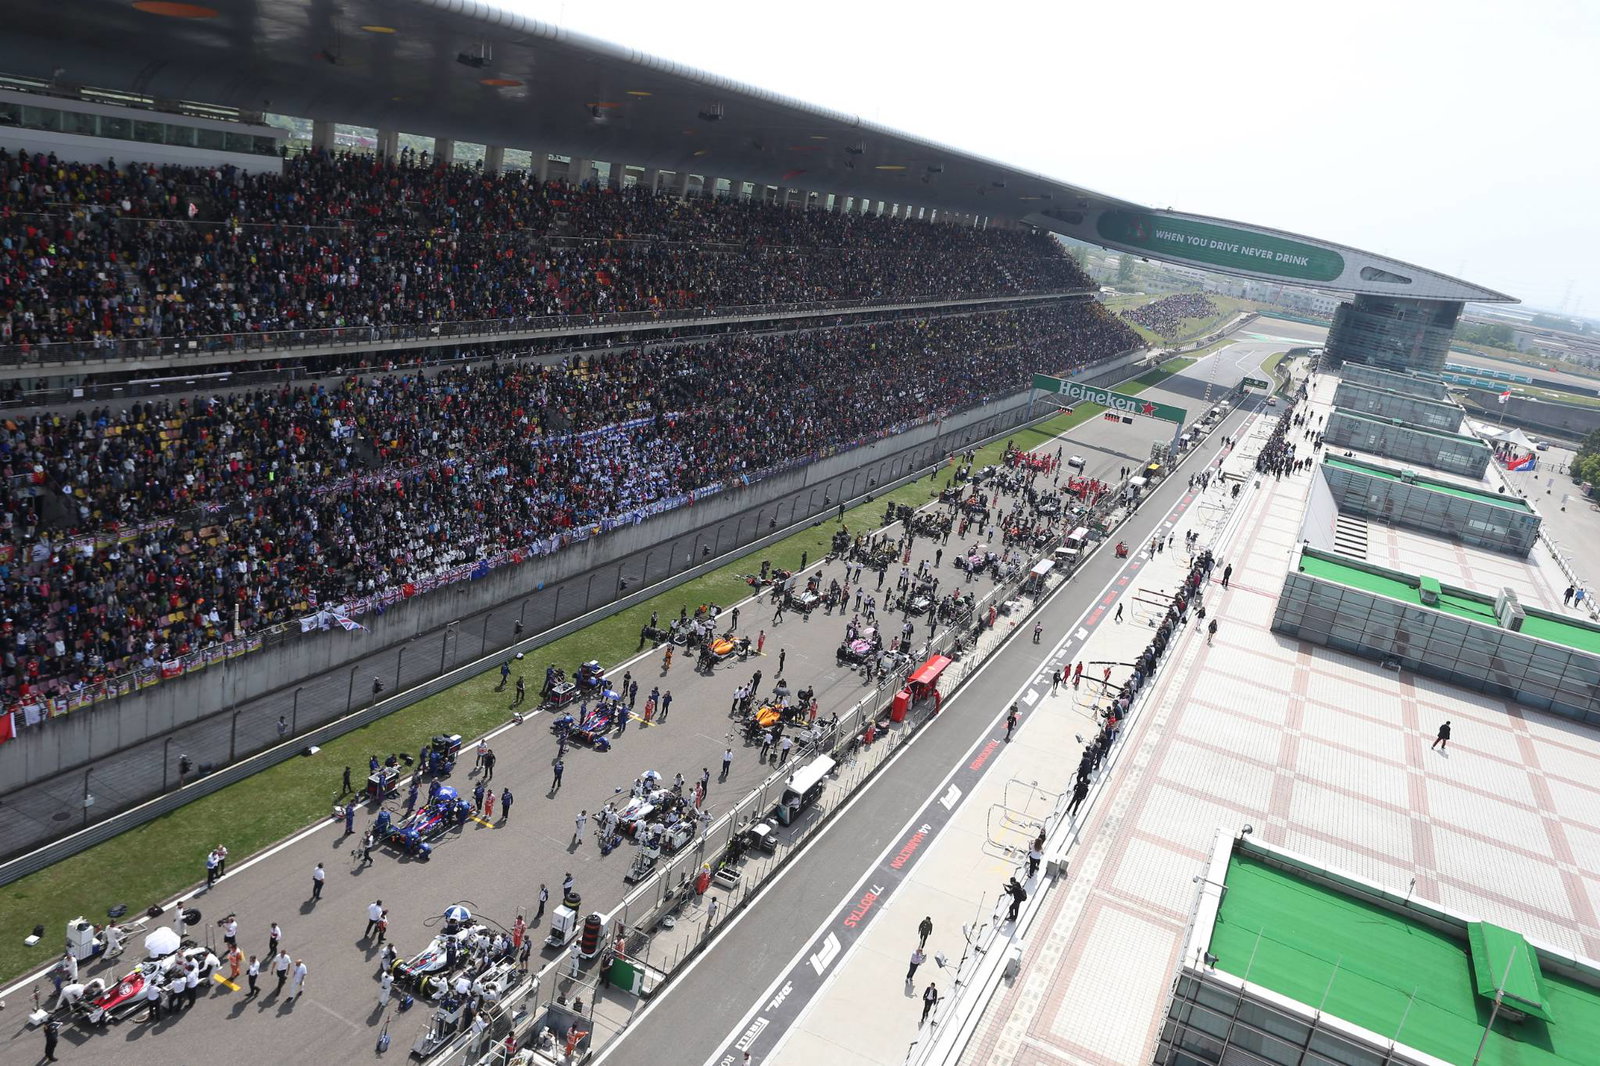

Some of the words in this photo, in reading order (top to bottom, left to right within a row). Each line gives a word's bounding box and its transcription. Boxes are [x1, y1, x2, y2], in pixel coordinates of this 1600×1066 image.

[1155, 230, 1185, 243] WHEN
[1187, 235, 1208, 247] YOU
[1210, 240, 1239, 253] DRIVE
[1241, 246, 1274, 260] NEVER
[1275, 252, 1309, 266] DRINK
[1058, 381, 1136, 412] Heineken
[764, 980, 793, 1012] DHL
[734, 1016, 770, 1052] PIRELLI
